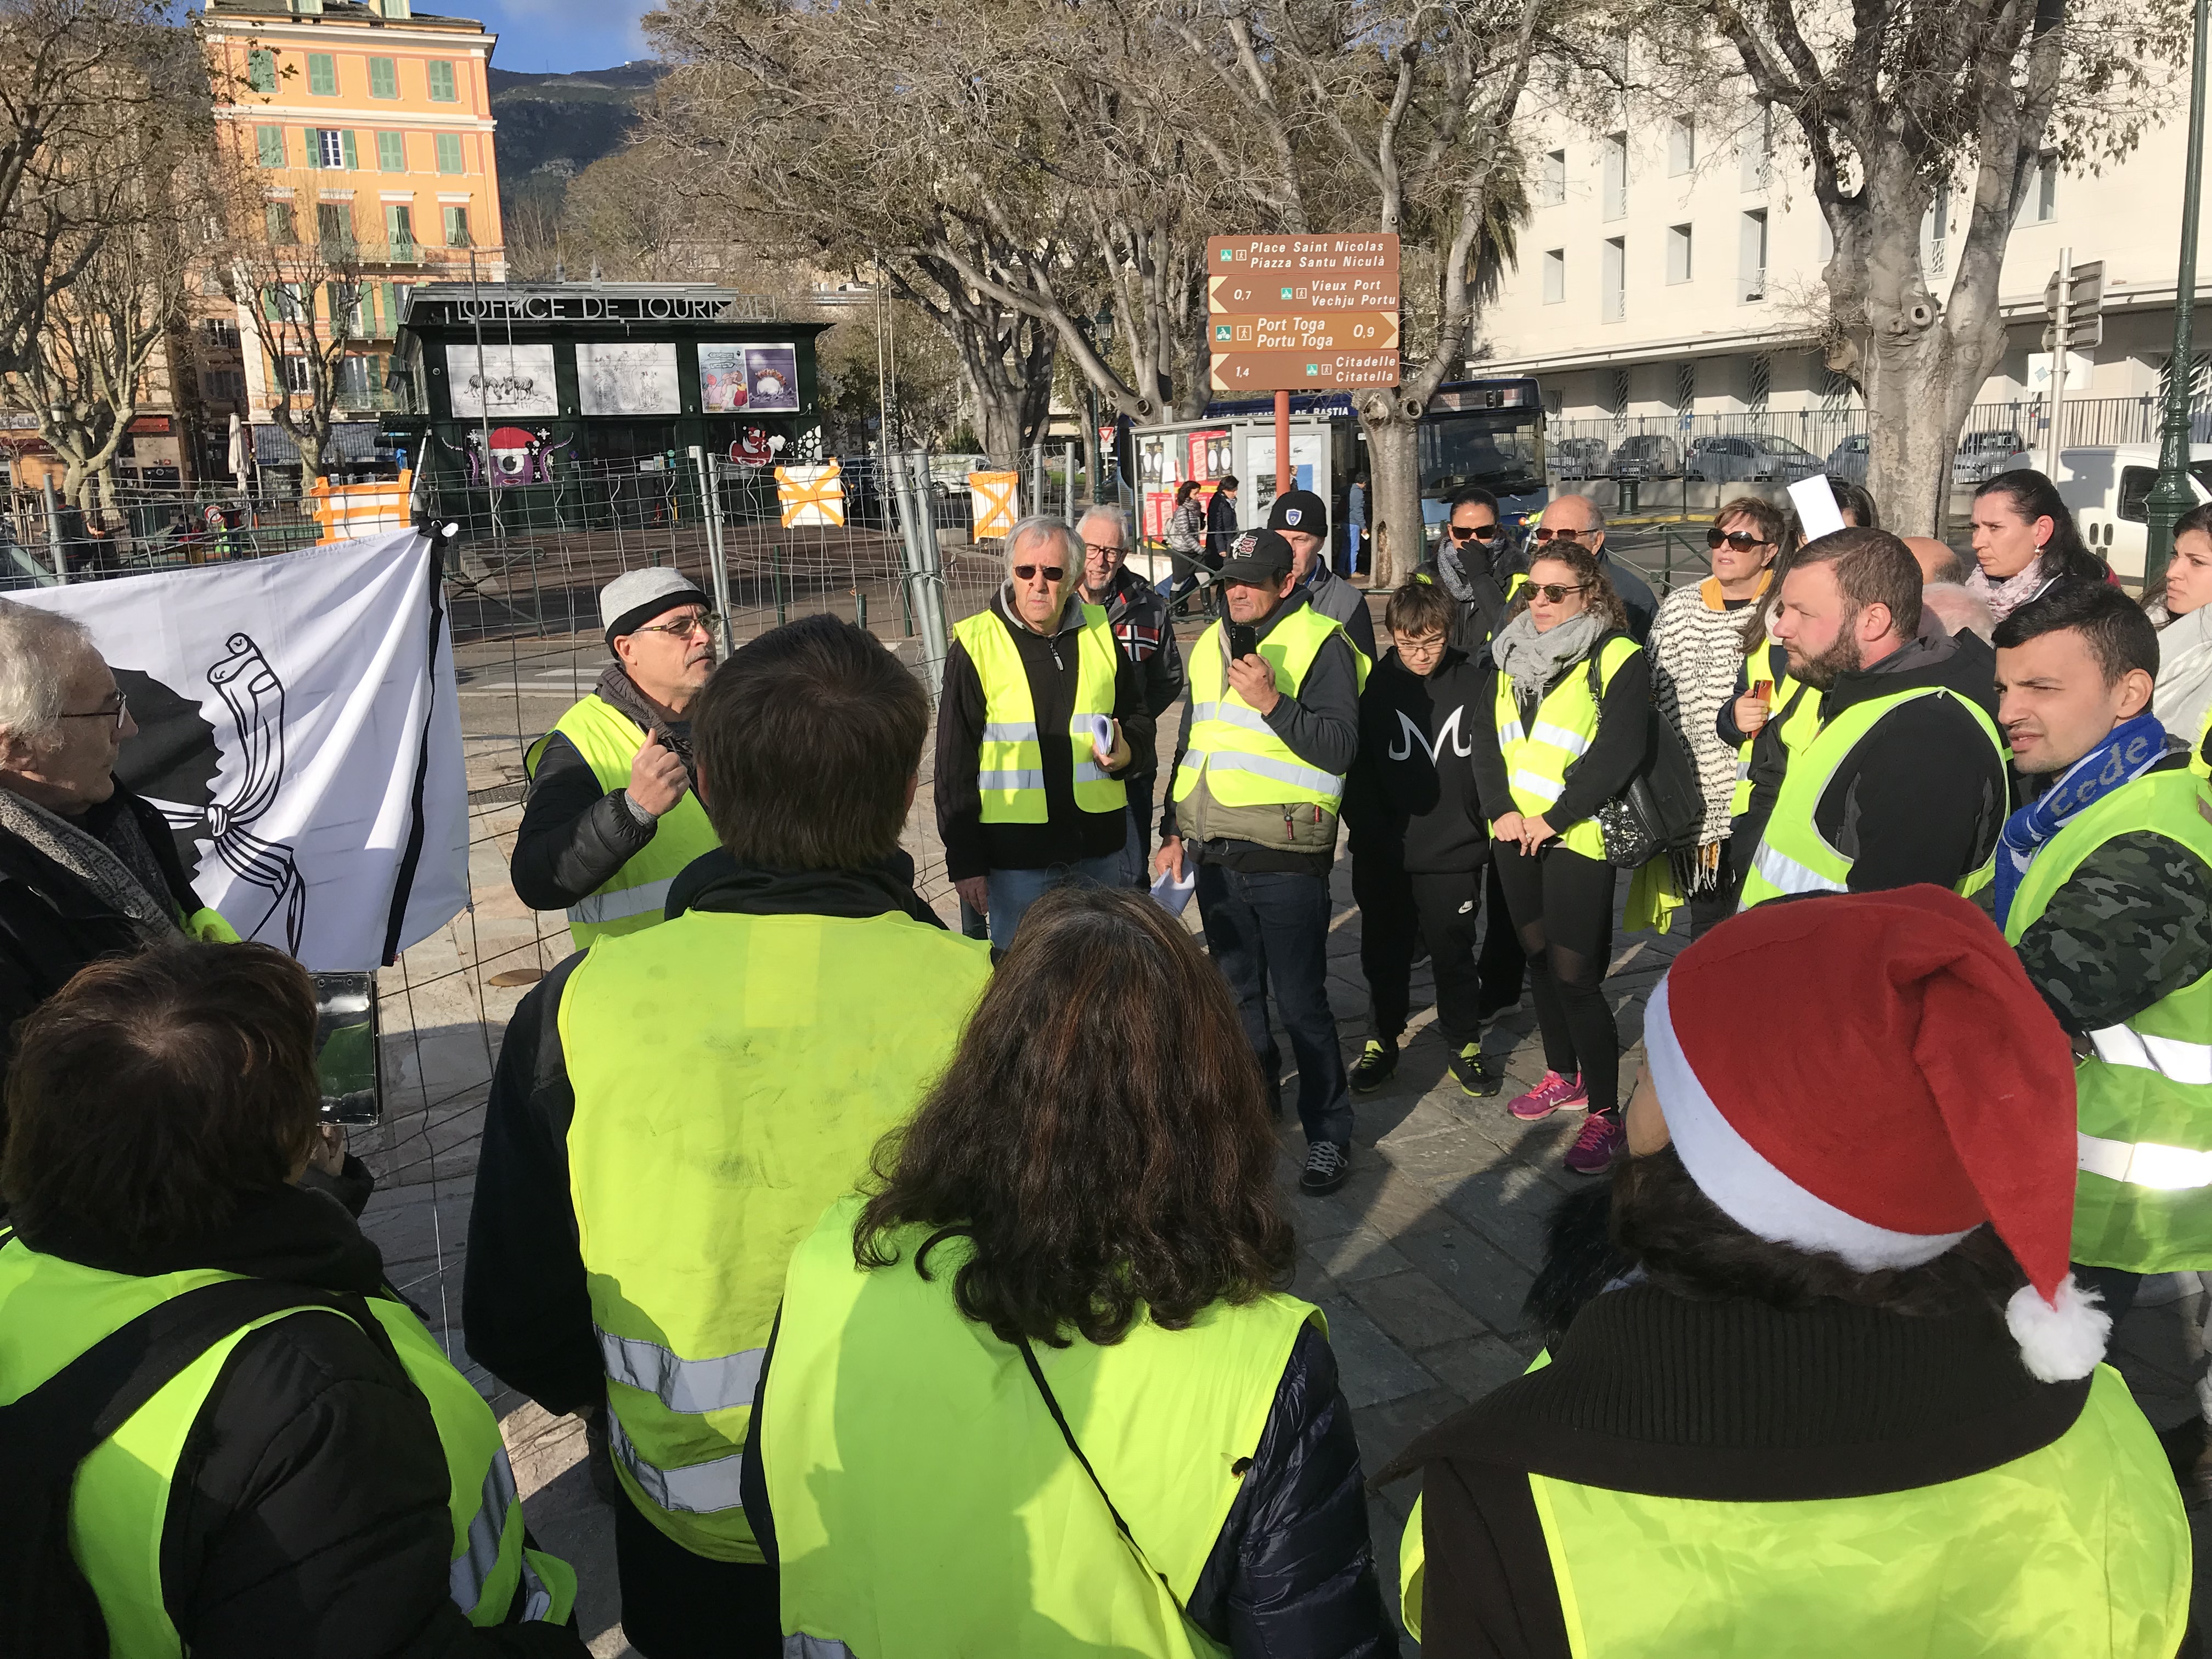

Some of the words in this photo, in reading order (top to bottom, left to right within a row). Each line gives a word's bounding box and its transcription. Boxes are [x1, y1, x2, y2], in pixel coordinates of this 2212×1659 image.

[1250, 242, 1286, 253] Place
[1293, 241, 1328, 252] Saint
[1335, 240, 1384, 252] Nicolas
[1250, 257, 1292, 268] Piazza
[1299, 256, 1336, 268] Santu
[1342, 255, 1385, 267] Niculà
[1312, 280, 1347, 291] Vieux
[1353, 279, 1381, 290] Port
[1234, 289, 1252, 301] 0,7
[1312, 295, 1355, 308] Vechju
[1361, 294, 1396, 305] Portu
[583, 296, 619, 319] DE
[1256, 318, 1287, 331] Port
[1293, 317, 1325, 334] Toga
[1353, 324, 1375, 338] 0,9
[1257, 334, 1295, 348] Portu
[1301, 332, 1333, 350] Toga
[1336, 356, 1396, 368] Citadelle
[1236, 366, 1250, 378] 1,4
[1336, 370, 1393, 382] Citatella
[1313, 407, 1349, 416] BASTIA
